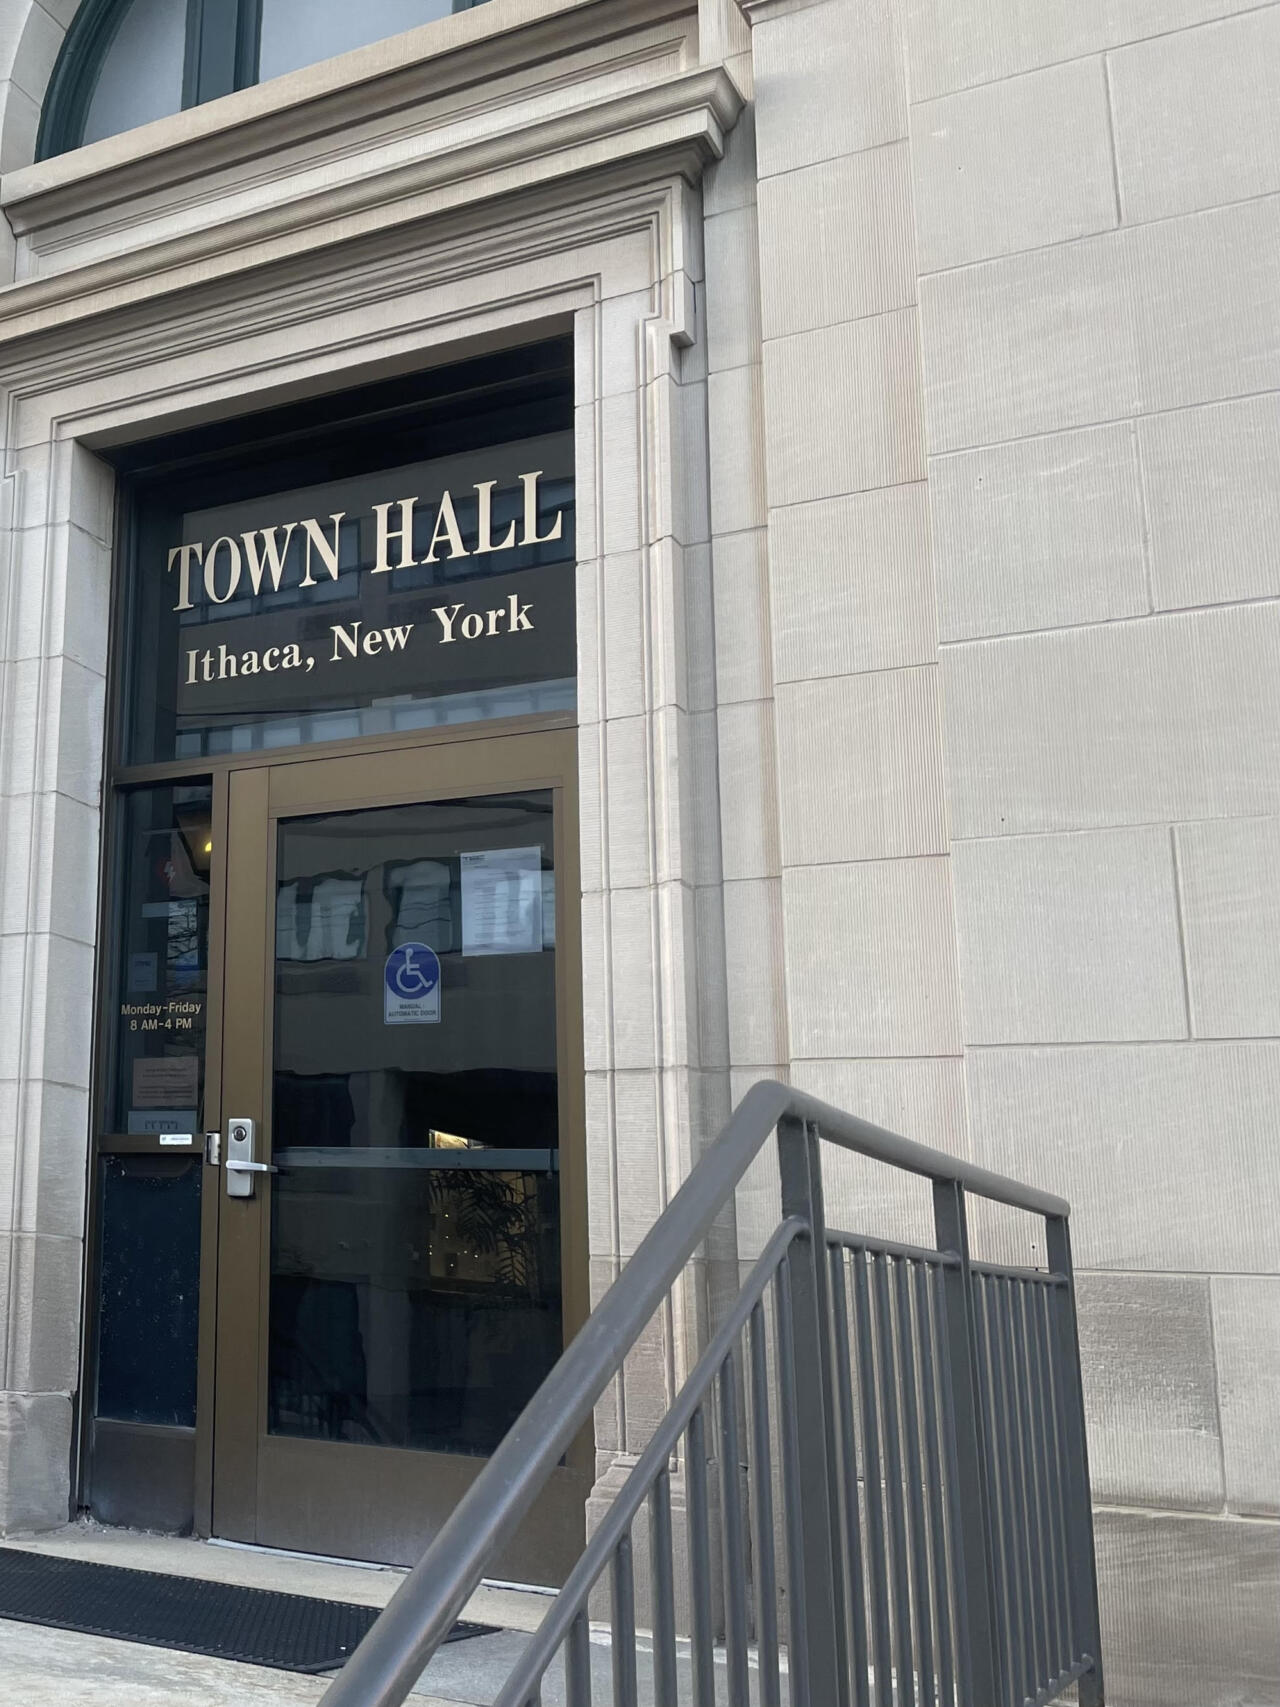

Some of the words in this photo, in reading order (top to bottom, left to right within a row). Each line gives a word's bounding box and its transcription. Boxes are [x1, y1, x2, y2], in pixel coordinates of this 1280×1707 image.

[168, 512, 346, 611] TOWN
[371, 470, 562, 574] HALL
[185, 643, 316, 685] Ithaca,
[329, 621, 414, 661] New
[431, 593, 535, 644] York
[130, 1020, 137, 1031] 8
[175, 1018, 192, 1029] PM
